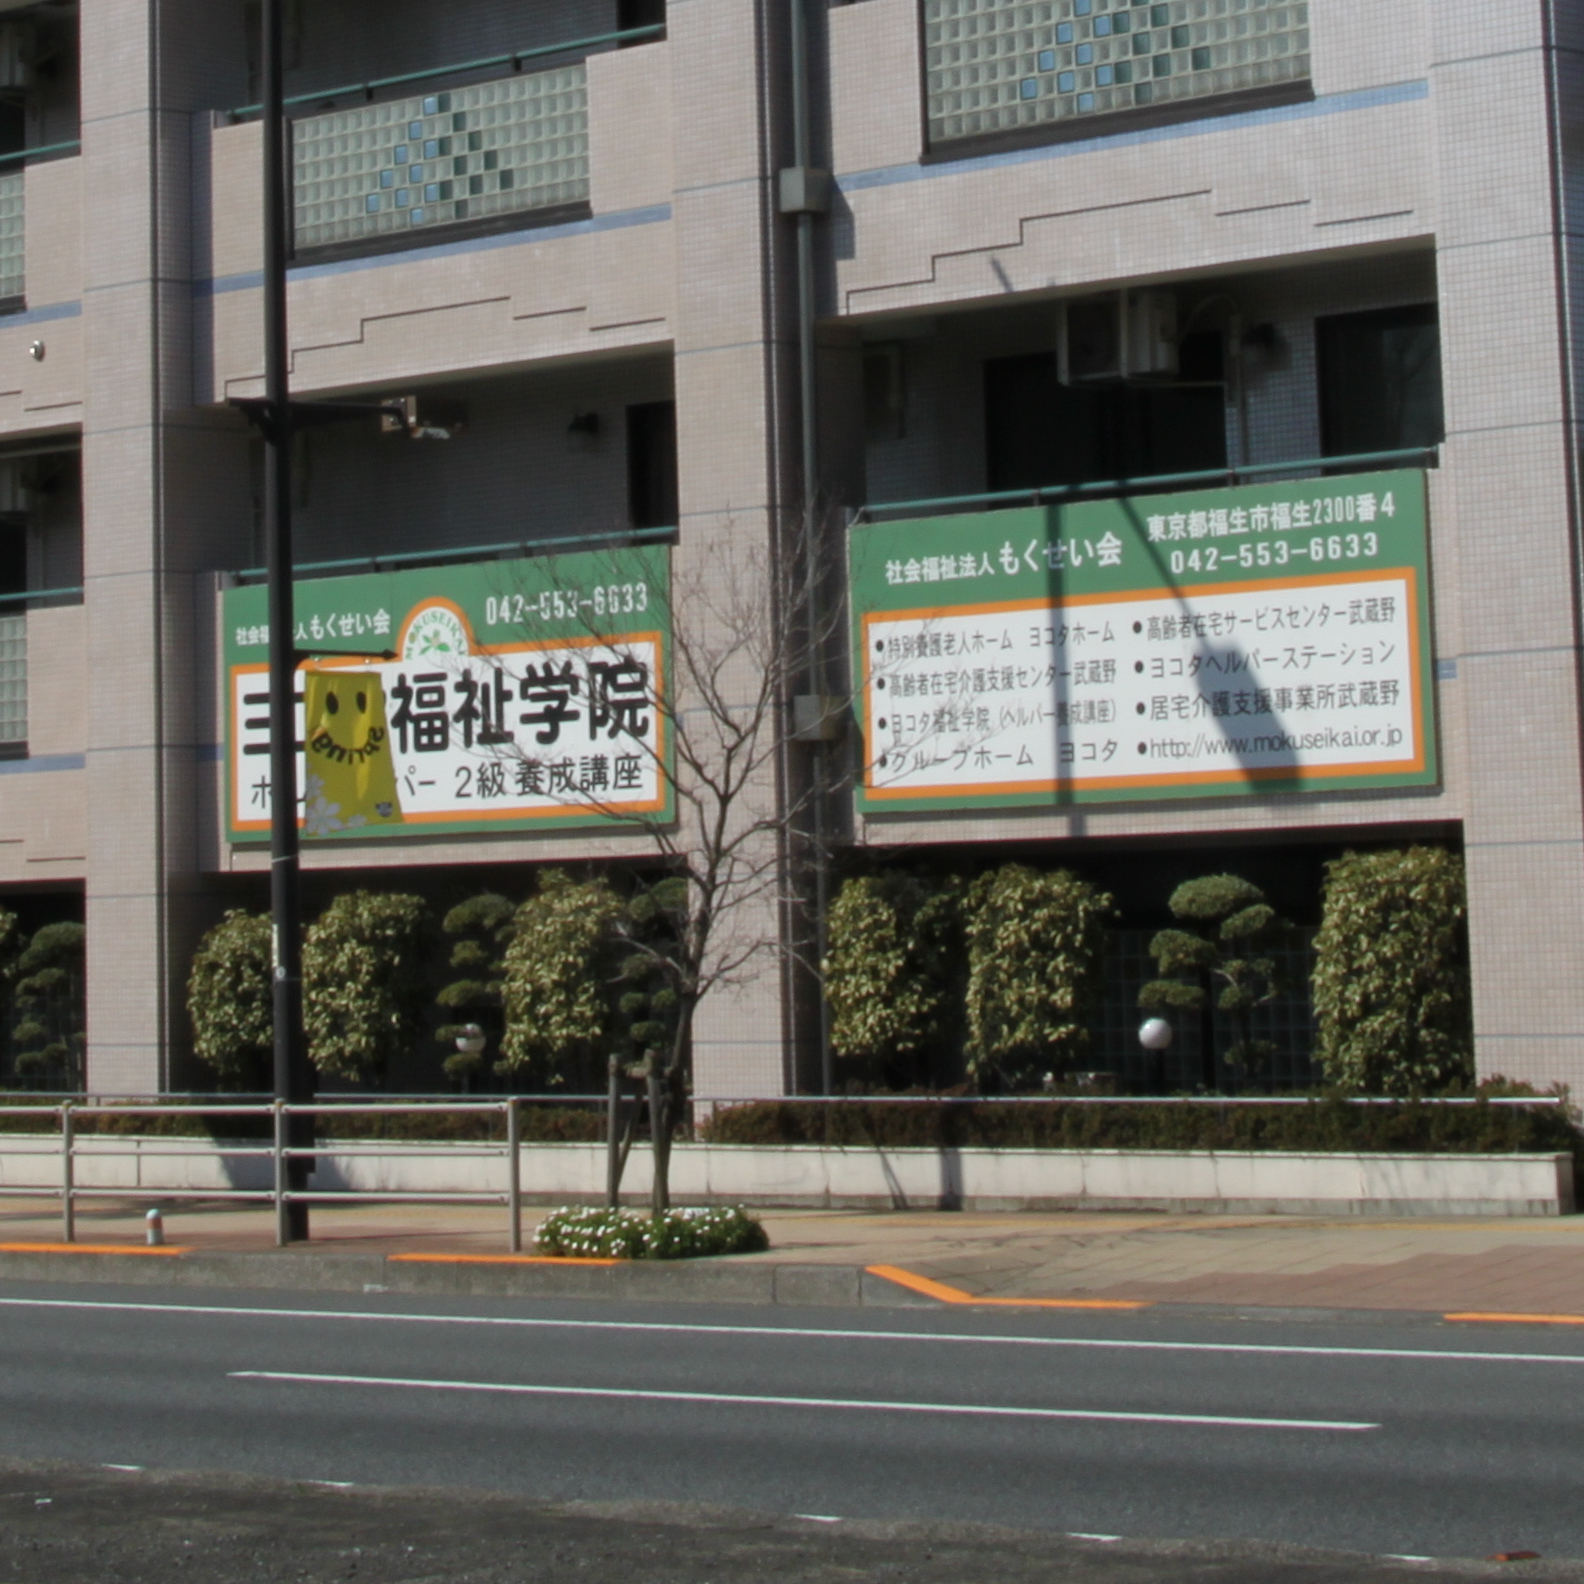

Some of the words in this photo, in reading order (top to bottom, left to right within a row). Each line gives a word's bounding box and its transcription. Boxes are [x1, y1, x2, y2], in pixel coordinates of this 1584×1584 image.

[1146, 491, 1396, 542] 東京都福生市福生2300番4
[1170, 532, 1378, 574] 042-553-6633
[1030, 621, 1116, 647] ヨコタホーム
[1147, 596, 1396, 641] 高齢者在宅サービスセンター武蔵野
[1151, 640, 1395, 678] ヨコタヘルパーステーション
[1150, 679, 1400, 721] 居宅介護支援事業所武蔵野
[1059, 738, 1119, 764] ヨコタ
[1150, 723, 1403, 760] http://www.mokuseikai.or.jp
